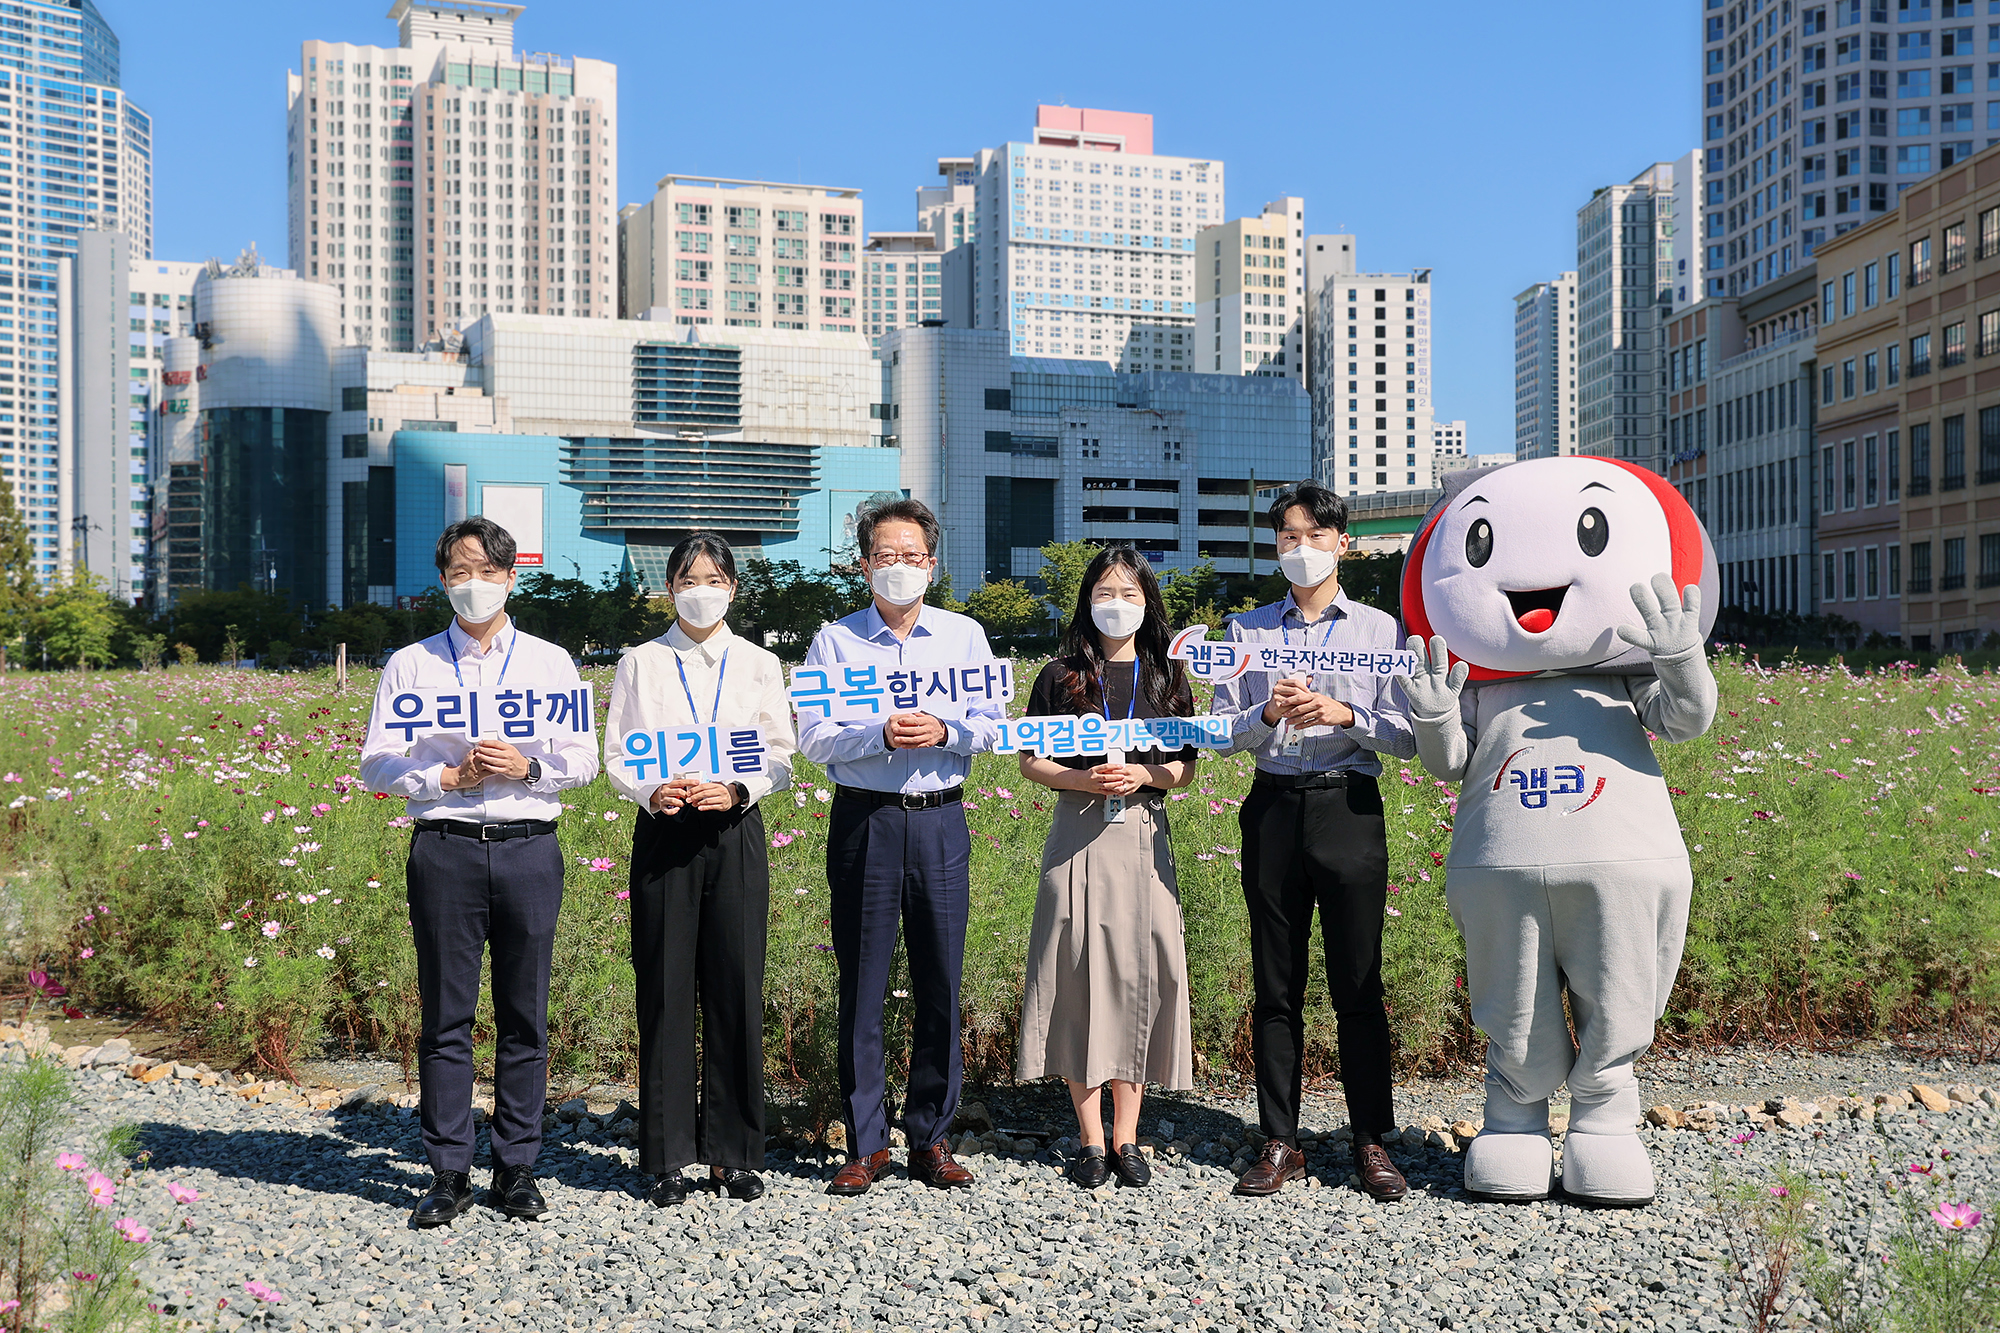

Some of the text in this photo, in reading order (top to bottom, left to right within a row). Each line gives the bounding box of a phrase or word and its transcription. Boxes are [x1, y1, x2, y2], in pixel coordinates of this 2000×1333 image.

[1185, 644, 1415, 675] 캠코 한국자산관리공사
[384, 688, 590, 742] 우리 함께
[790, 664, 1009, 718] 극복합시다!
[623, 726, 766, 781] 위기를
[1509, 764, 1585, 810] 캠코
